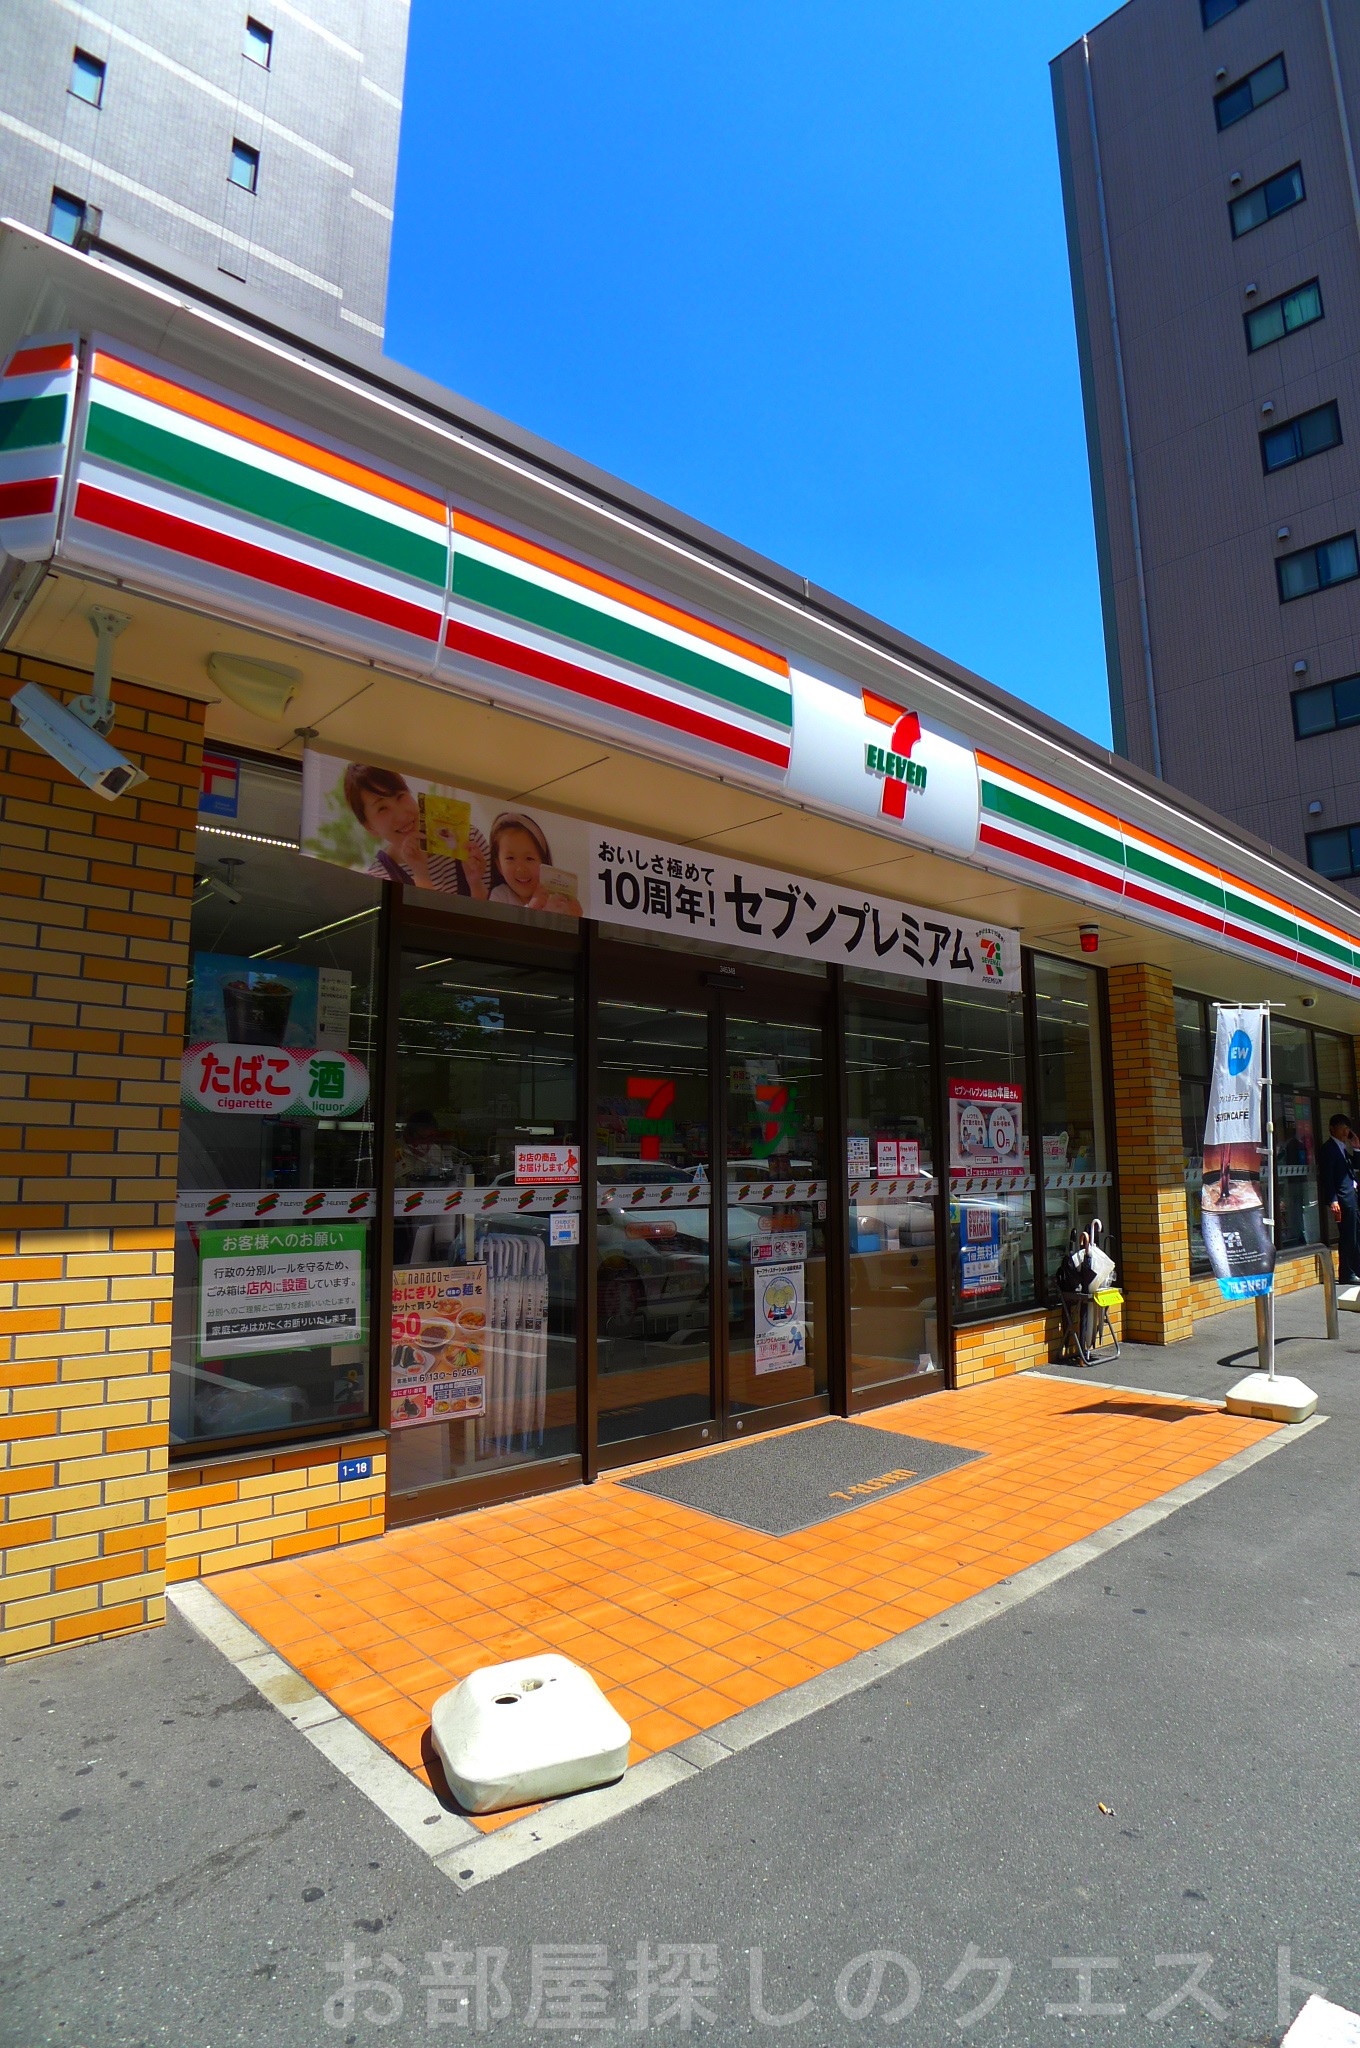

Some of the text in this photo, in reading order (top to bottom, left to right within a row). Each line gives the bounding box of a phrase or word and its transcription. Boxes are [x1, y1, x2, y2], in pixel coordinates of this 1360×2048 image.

[597, 840, 715, 887] おいしさ極めて
[598, 868, 717, 928] 10周年!
[724, 873, 975, 973] セブンプレミアム
[982, 975, 1003, 985] PREMIUM
[200, 1052, 346, 1099] たばこ 酒
[217, 1097, 345, 1112] cigarette liquor
[996, 1128, 1011, 1149] 0円
[518, 1152, 557, 1162] お店の商品
[968, 1223, 991, 1238] FRIDAY
[222, 1231, 344, 1252] お客様へのお願い
[213, 1260, 350, 1280] 行政の分別ルールを守るため、
[206, 1276, 356, 1298] ごみ箱は店内に設置しています。
[206, 1297, 355, 1318] 分別へのご理解とご協力をお願いいたします。
[392, 1300, 439, 1313] セットで買うと
[211, 1313, 353, 1336] 家庭ごみはかたくお断りいたします。
[391, 1311, 421, 1340] 50
[342, 1462, 367, 1477] 1-18
